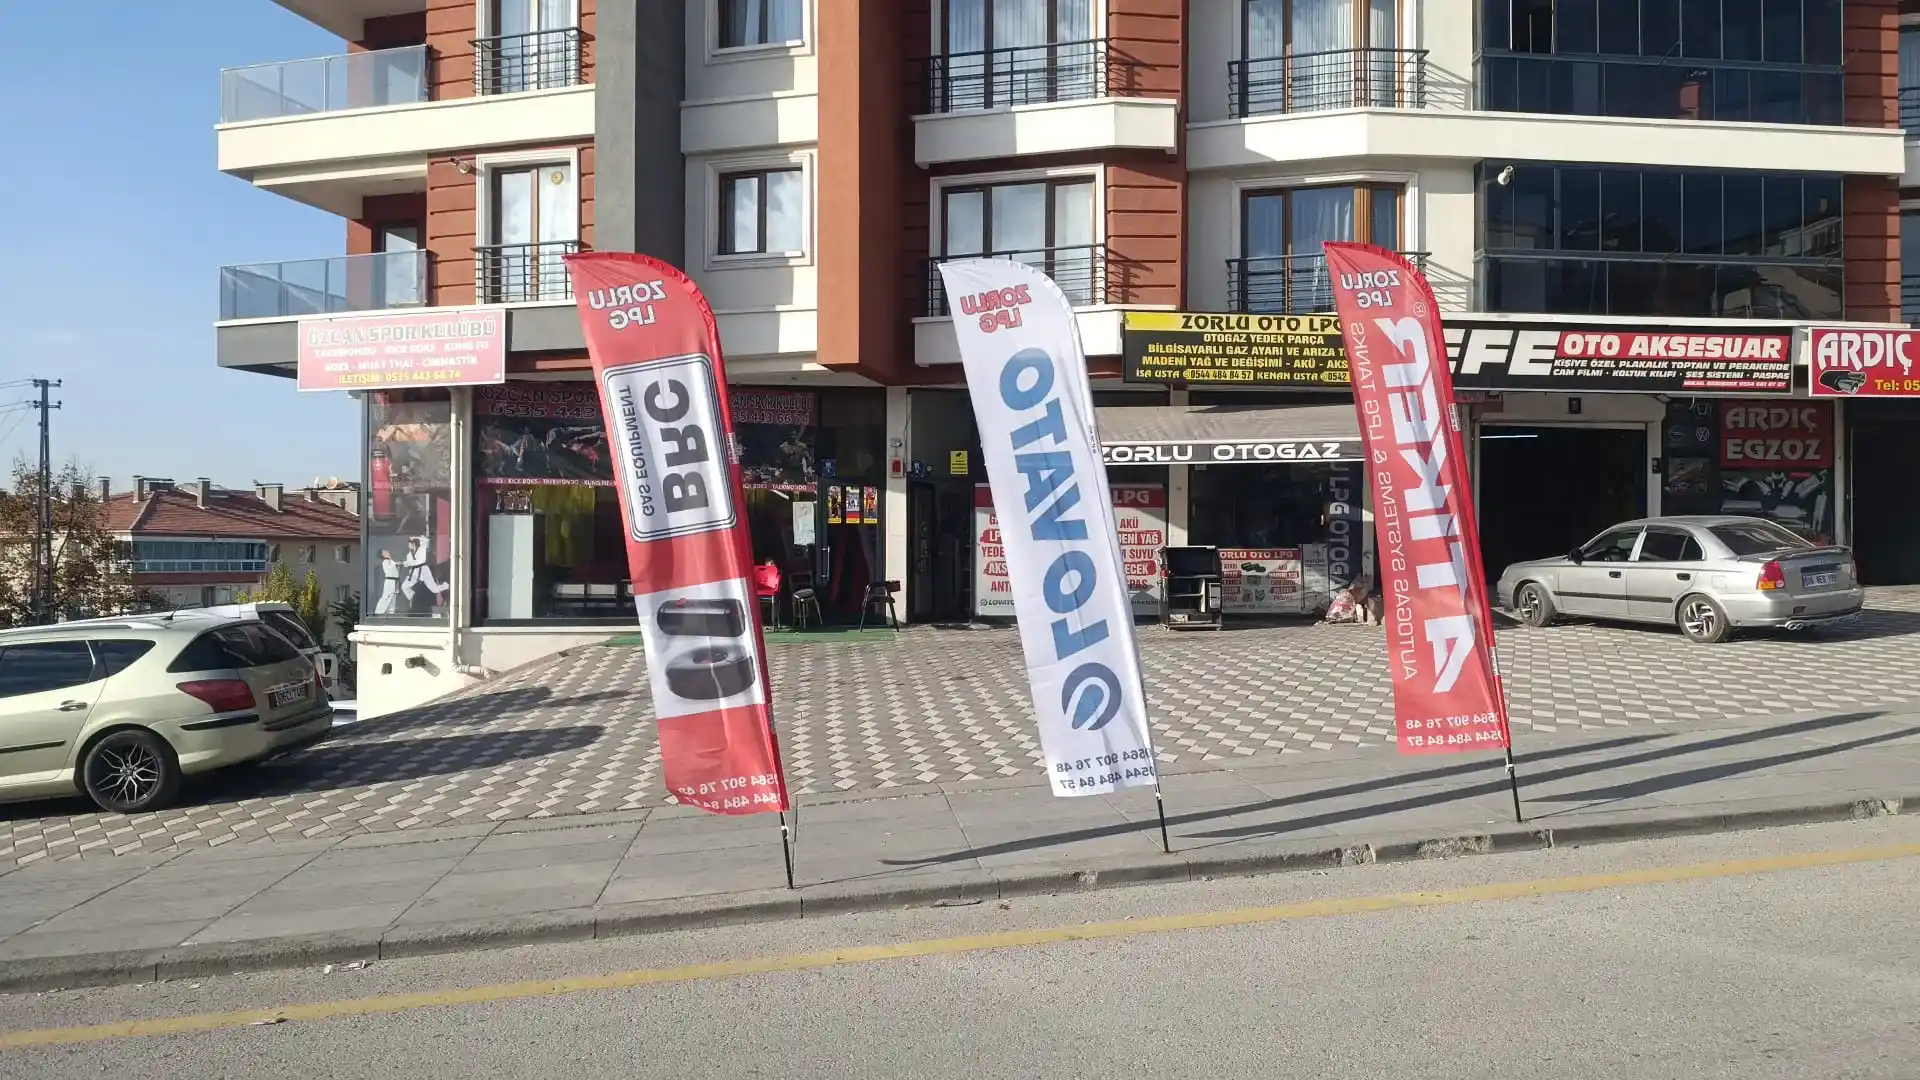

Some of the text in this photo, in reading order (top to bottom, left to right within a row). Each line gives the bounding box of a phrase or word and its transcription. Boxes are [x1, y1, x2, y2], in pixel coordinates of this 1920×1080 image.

[1181, 315, 1250, 331] ZORLU
[1257, 316, 1301, 331] OTO
[308, 317, 496, 346] ÖZCAN SPOR KULÜBÜ
[1203, 333, 1325, 346] OTOGAZ YEDEK PARÇA
[1563, 333, 1781, 359] OTO AKSESUAR
[1148, 343, 1223, 354] BİLGİSAYARLI
[1226, 345, 1248, 355] GAZ
[1251, 346, 1283, 356] AYARI
[1286, 347, 1300, 356] VE
[1302, 347, 1335, 357] ARIZA
[1817, 332, 1913, 376] ARDIÇ
[1142, 353, 1187, 366] MADENİ
[1190, 354, 1212, 367] YAĞ
[1215, 357, 1228, 367] VE
[1231, 356, 1283, 369] DEĞİŞİMİ
[1294, 357, 1316, 368] AKÜ
[1590, 357, 1616, 368] ÖZEL
[1619, 360, 1668, 369] PLAKALIK
[1671, 361, 1710, 370] TOPTAN
[1713, 361, 1726, 370] VE
[1729, 362, 1790, 371] PERAKENDE
[1155, 369, 1180, 378] USTA
[1190, 369, 1211, 379] 0544
[1212, 369, 1228, 379] 484
[1241, 370, 1252, 379] 57
[1257, 371, 1291, 380] KENAN
[1294, 372, 1318, 381] USTA
[1327, 372, 1348, 382] 0542
[1553, 369, 1577, 377] CAM
[1612, 369, 1647, 378] KOLTUK
[1874, 379, 1900, 391] Tel:
[550, 389, 598, 405] SPOR
[490, 402, 547, 416] 0535
[1725, 407, 1818, 433] ARDIÇ
[1213, 442, 1341, 460] OTOGAZ
[1726, 438, 1821, 460] EGZOZ
[1112, 489, 1150, 504] LPG
[1119, 517, 1139, 529] AKÜ
[981, 546, 1005, 558] YEDE
[1129, 549, 1154, 560] SUYU
[1249, 551, 1271, 559] OTO
[1273, 551, 1294, 559] LPG
[1128, 579, 1148, 590] PAS
